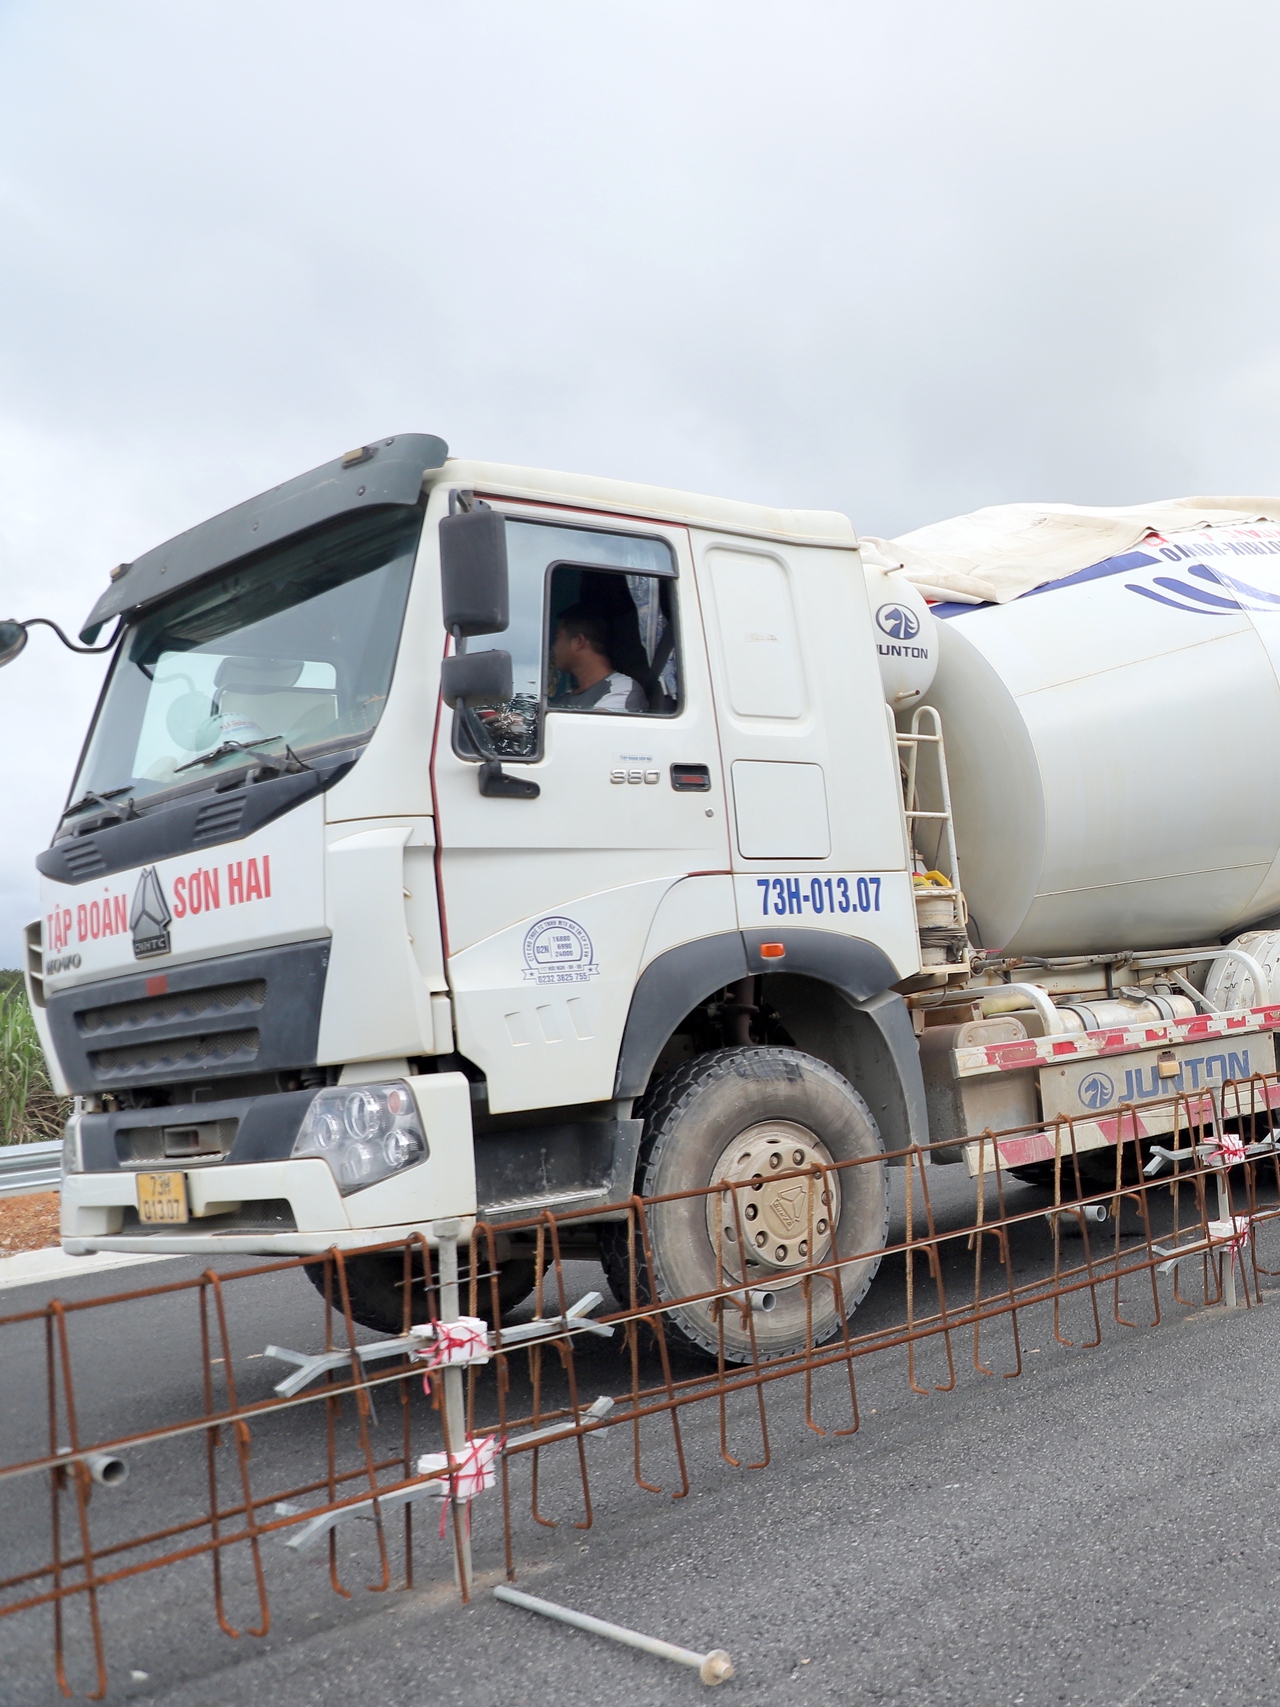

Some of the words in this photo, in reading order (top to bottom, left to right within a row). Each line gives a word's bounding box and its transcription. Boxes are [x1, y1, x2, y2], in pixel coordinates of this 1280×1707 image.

[610, 769, 661, 785] 380
[173, 868, 220, 919] SƠN
[756, 876, 882, 916] 73H-013.07
[46, 904, 72, 954] TẬP
[46, 953, 82, 976] HOWO
[538, 975, 555, 984] 0232
[575, 972, 588, 980] 755
